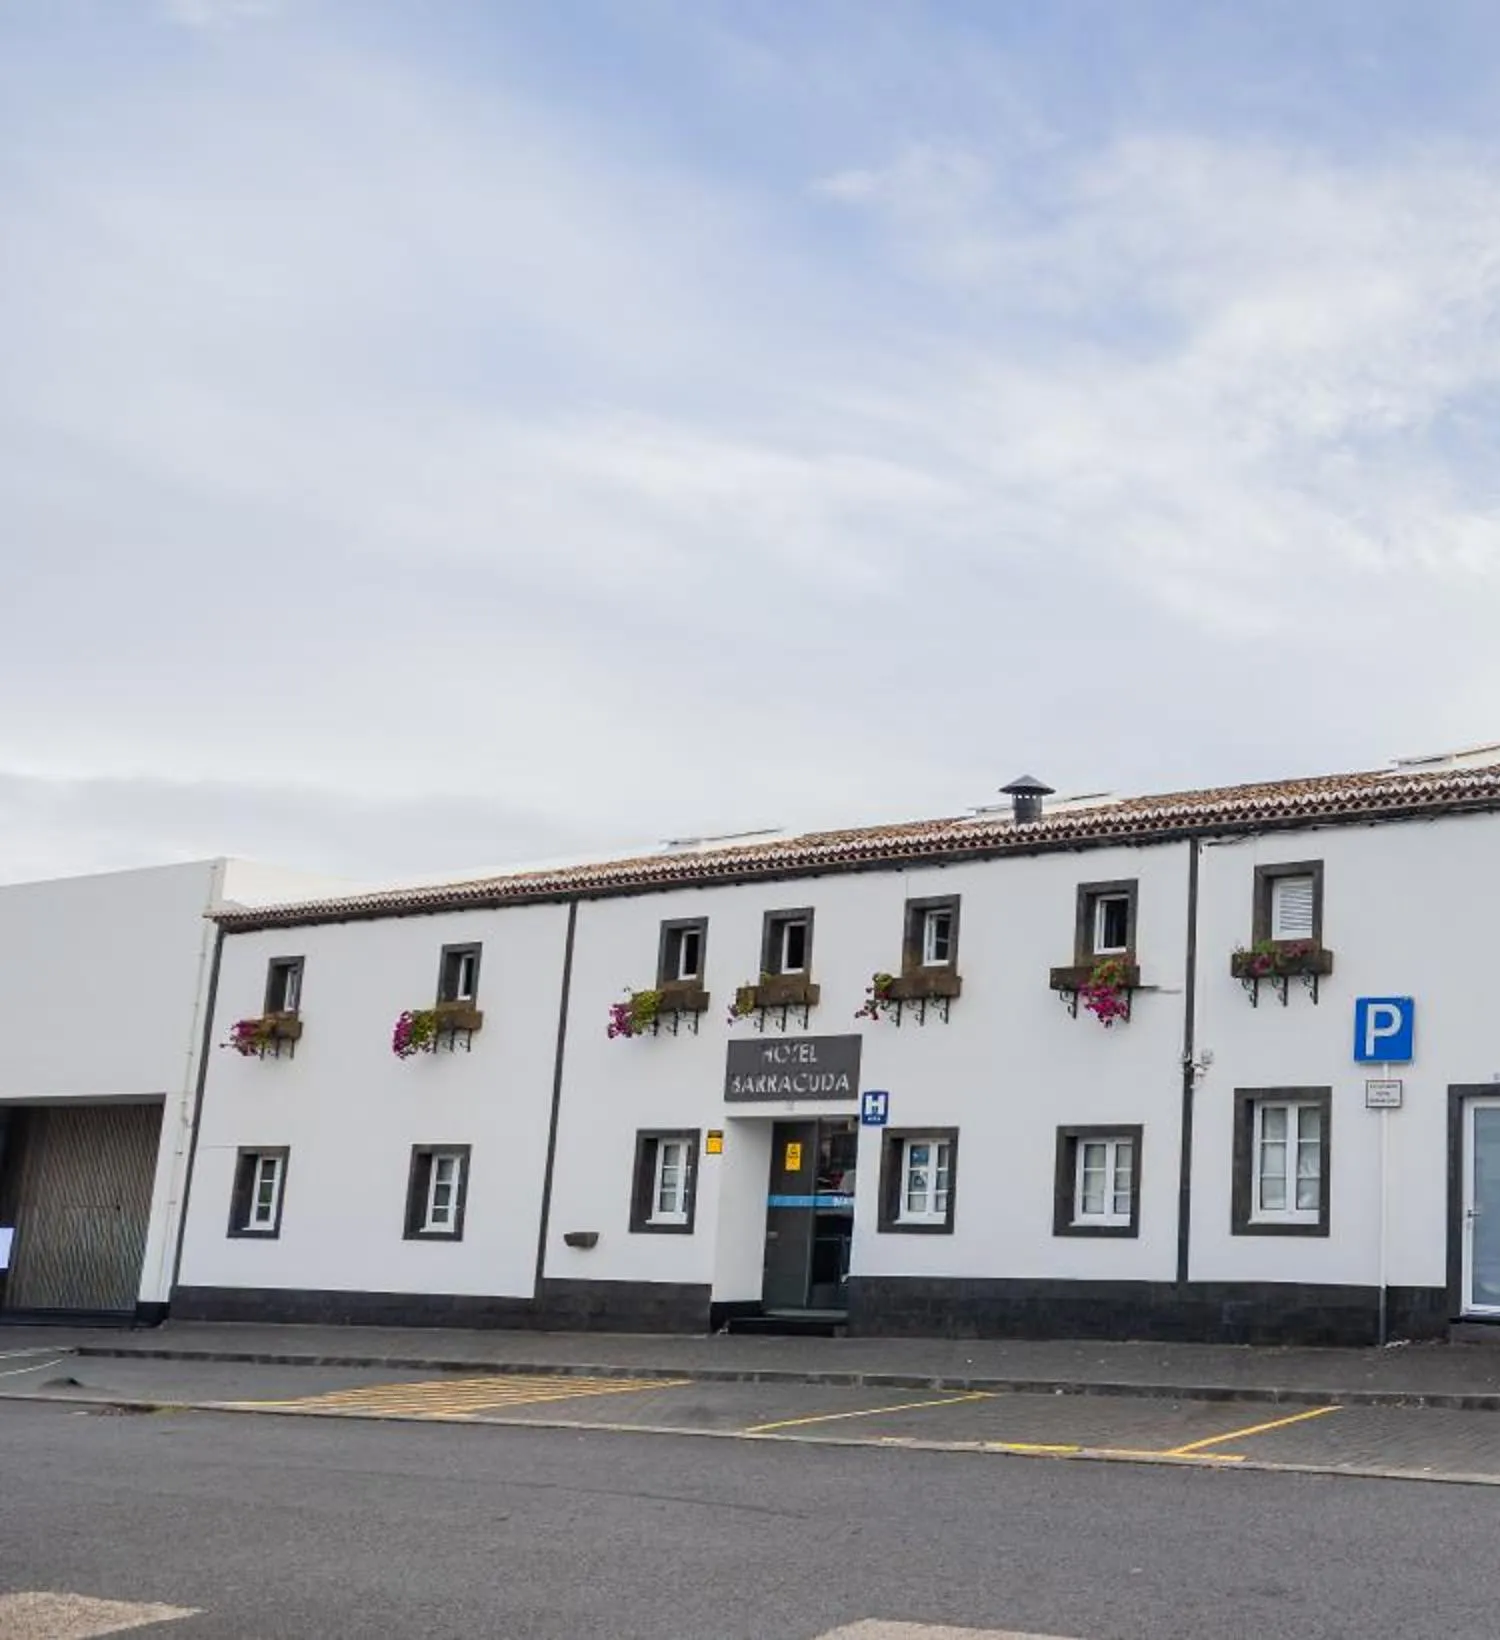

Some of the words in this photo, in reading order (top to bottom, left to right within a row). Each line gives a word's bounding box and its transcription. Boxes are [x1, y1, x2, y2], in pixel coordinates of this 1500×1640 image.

[1366, 1003, 1402, 1056] P
[763, 1043, 817, 1063] HOTEL
[731, 1073, 850, 1093] BARRACUDA
[865, 1095, 885, 1115] H
